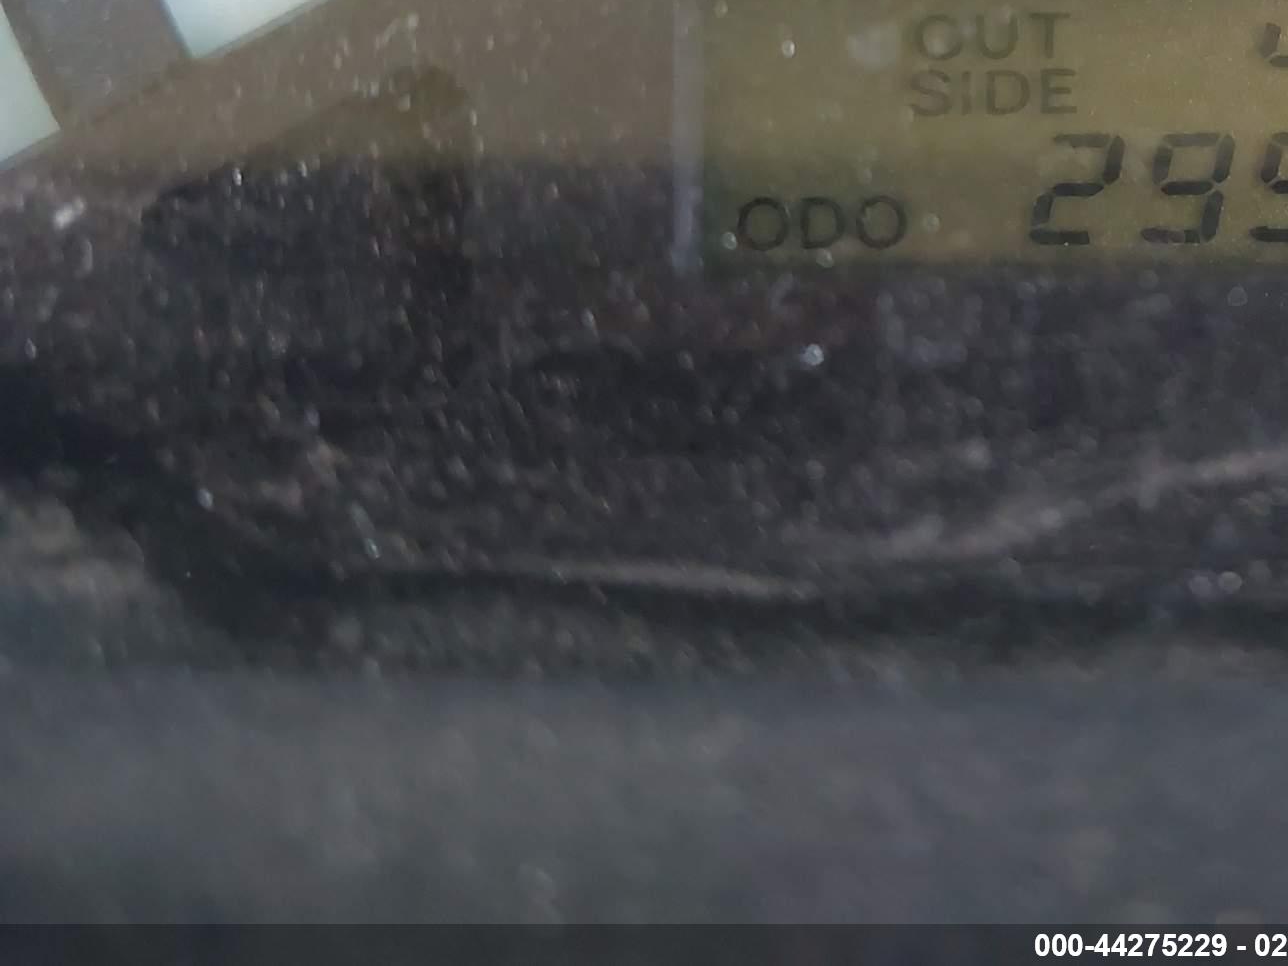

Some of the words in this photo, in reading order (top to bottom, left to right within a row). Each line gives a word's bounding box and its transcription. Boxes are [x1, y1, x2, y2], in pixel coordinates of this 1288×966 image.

[914, 13, 1071, 61] OUT
[910, 67, 1078, 116] SIDE
[738, 194, 908, 251] ODO
